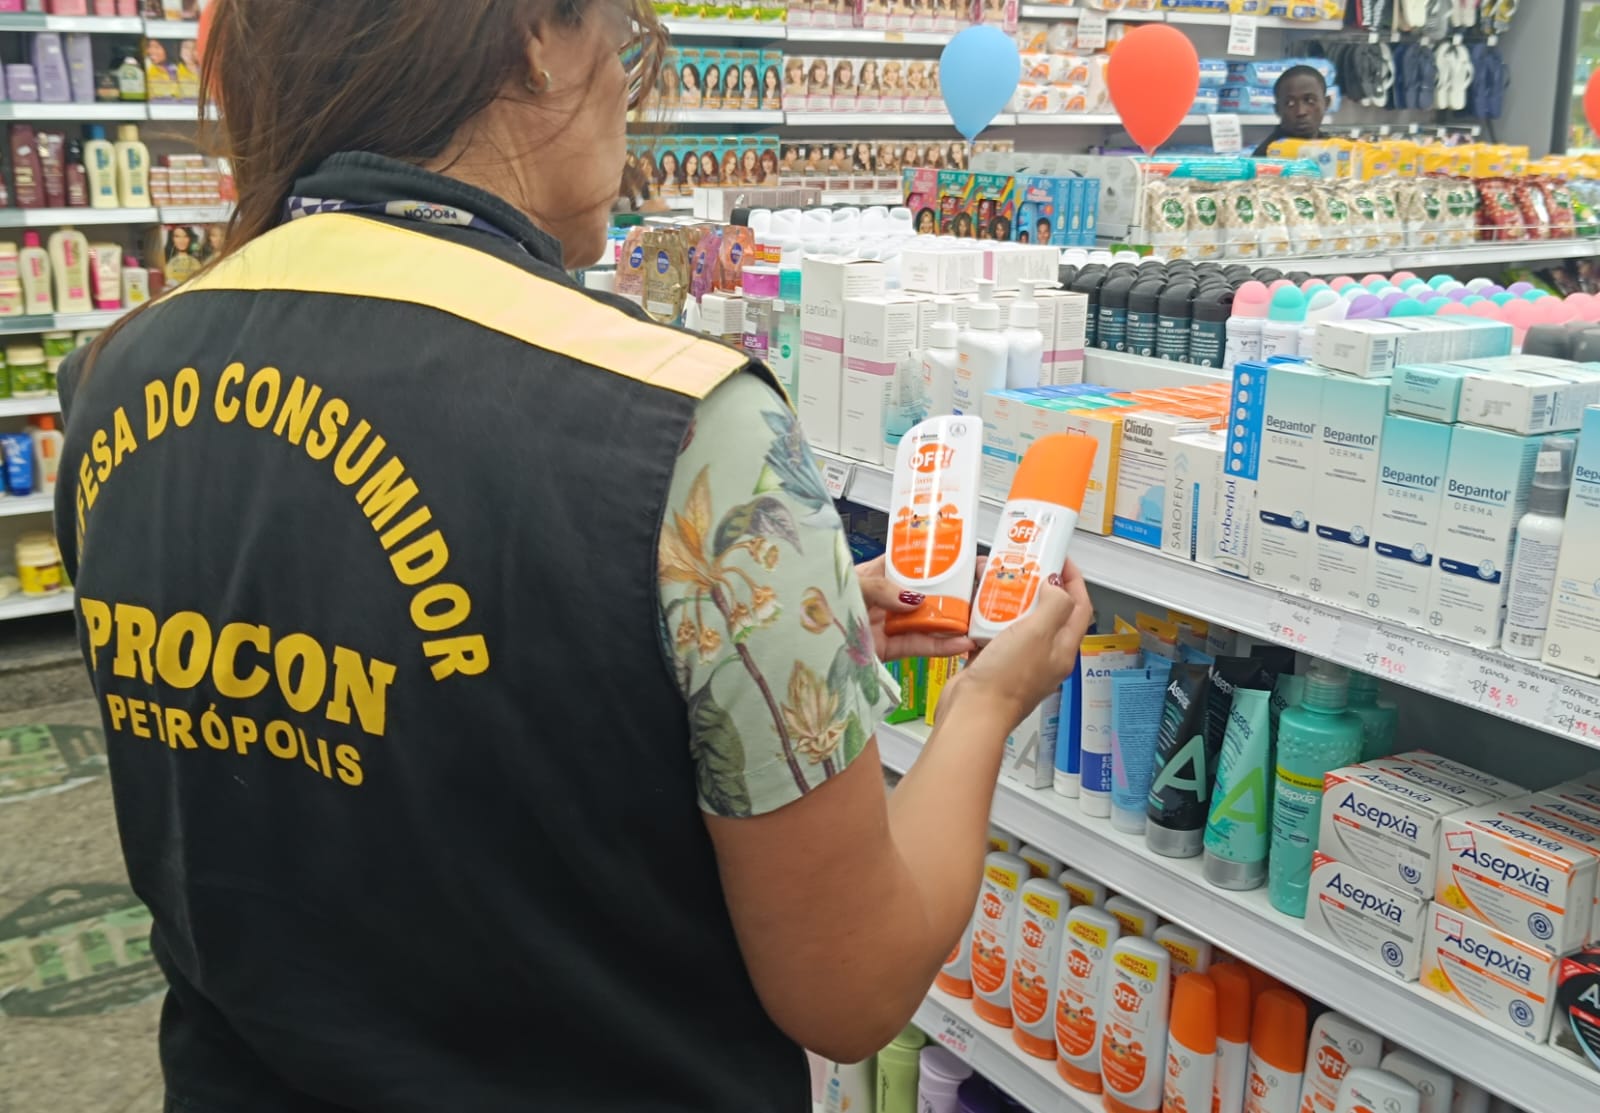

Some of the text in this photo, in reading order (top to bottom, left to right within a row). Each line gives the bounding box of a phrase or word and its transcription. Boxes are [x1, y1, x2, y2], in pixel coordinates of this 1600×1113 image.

[403, 207, 457, 220] PROCON
[1124, 418, 1153, 438] Clindo
[1266, 415, 1315, 434] Bepantol
[1323, 426, 1376, 446] Bepantol
[1382, 466, 1438, 487] Bepantol
[1448, 479, 1509, 502] Bepantol
[144, 366, 199, 441] DO
[214, 362, 489, 682] CONSUMIDOR
[1171, 477, 1184, 550] SABOFEN
[80, 597, 397, 737] PROCON
[106, 694, 364, 787] PETRÓPOLIS
[1360, 773, 1432, 803] Asepxia
[1393, 764, 1466, 796] Asepxia
[1339, 791, 1418, 840] Asepxia
[1512, 811, 1595, 842] Asepxia
[1480, 819, 1564, 852] Asepxia
[1460, 847, 1551, 894] Asepxia
[1326, 872, 1403, 923] Asepxia
[1067, 953, 1094, 980] OFF!
[1444, 935, 1532, 982] Asepxia
[1112, 985, 1144, 1014] OFF!
[1315, 1047, 1352, 1080] OFF!
